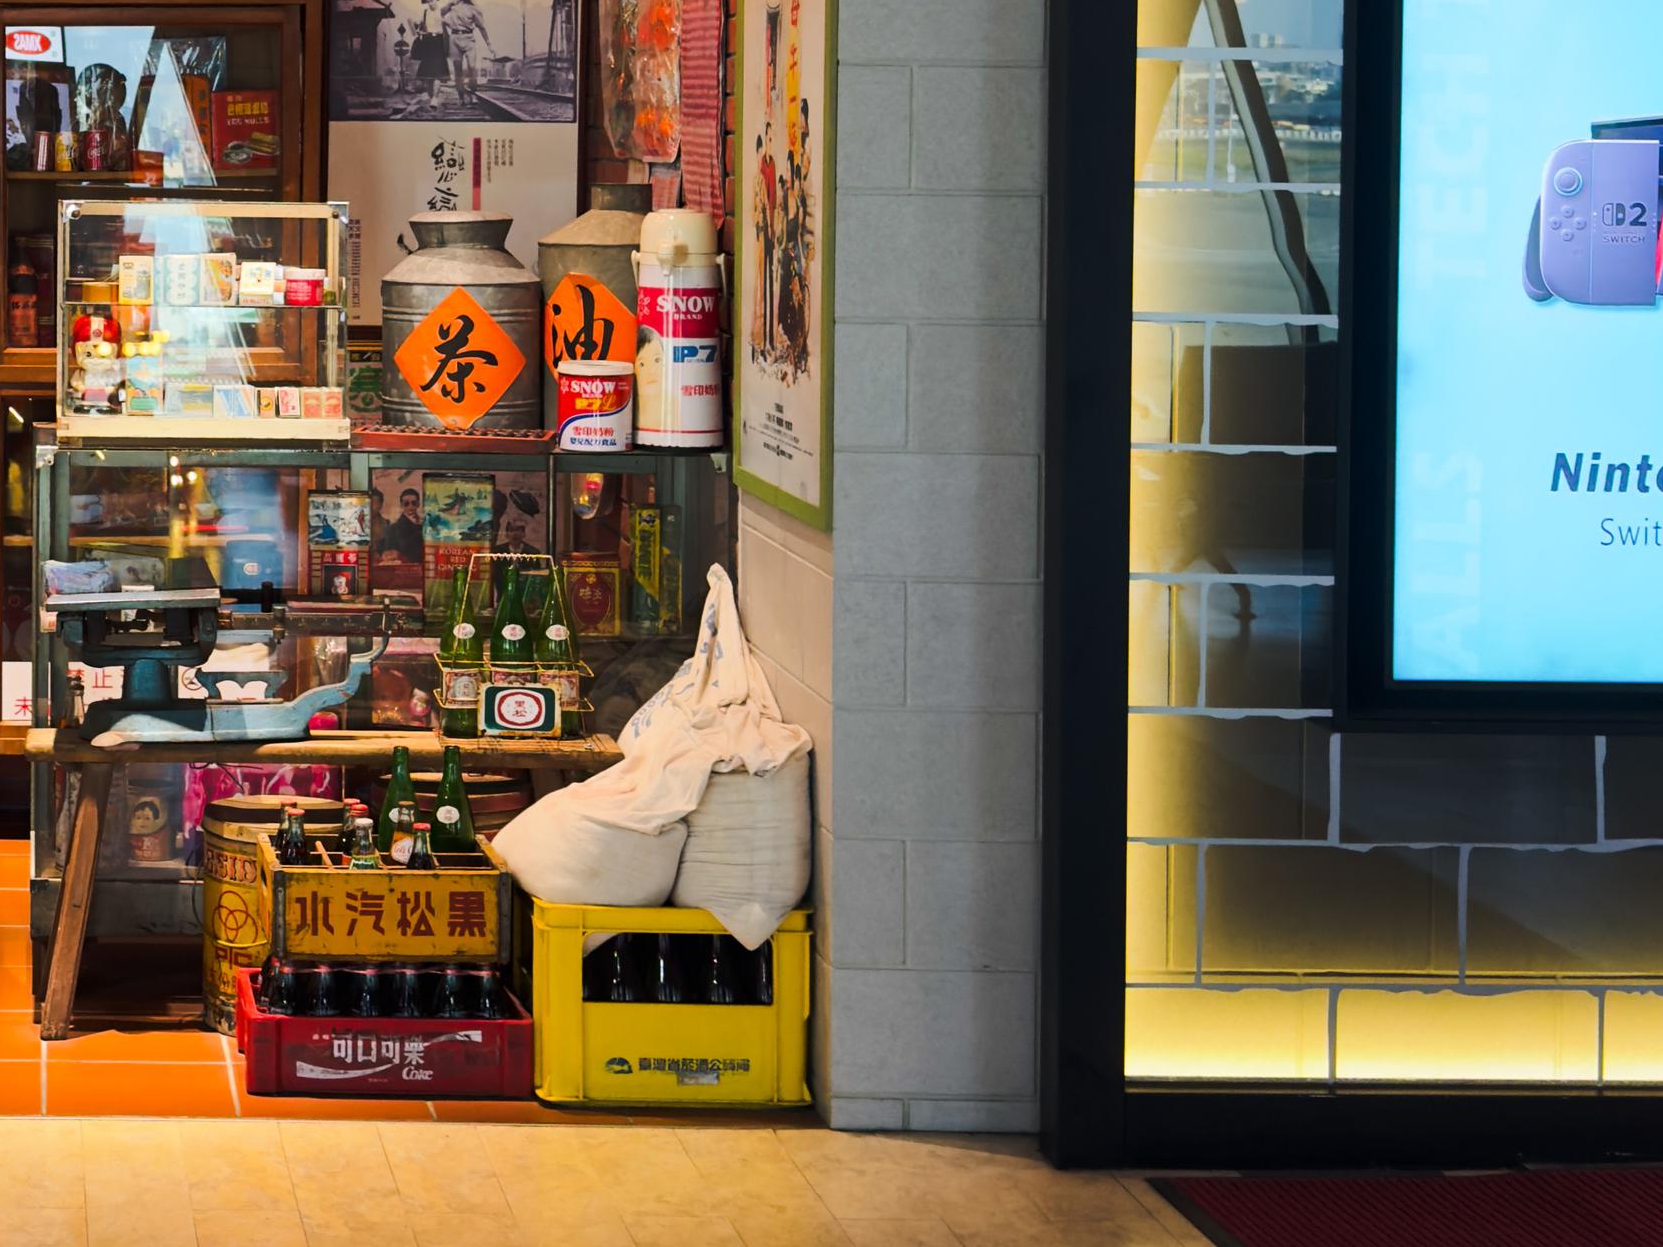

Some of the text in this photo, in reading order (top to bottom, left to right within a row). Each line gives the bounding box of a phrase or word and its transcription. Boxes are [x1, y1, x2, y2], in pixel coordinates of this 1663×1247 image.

[1629, 202, 1648, 227] 2
[1602, 235, 1647, 243] SWITCH
[656, 295, 716, 313] SNOW
[551, 283, 616, 369] 油
[419, 314, 499, 403] 茶
[570, 380, 616, 394] SNOW
[332, 1032, 426, 1065] 可口可樂
[401, 1066, 435, 1081] Coke
